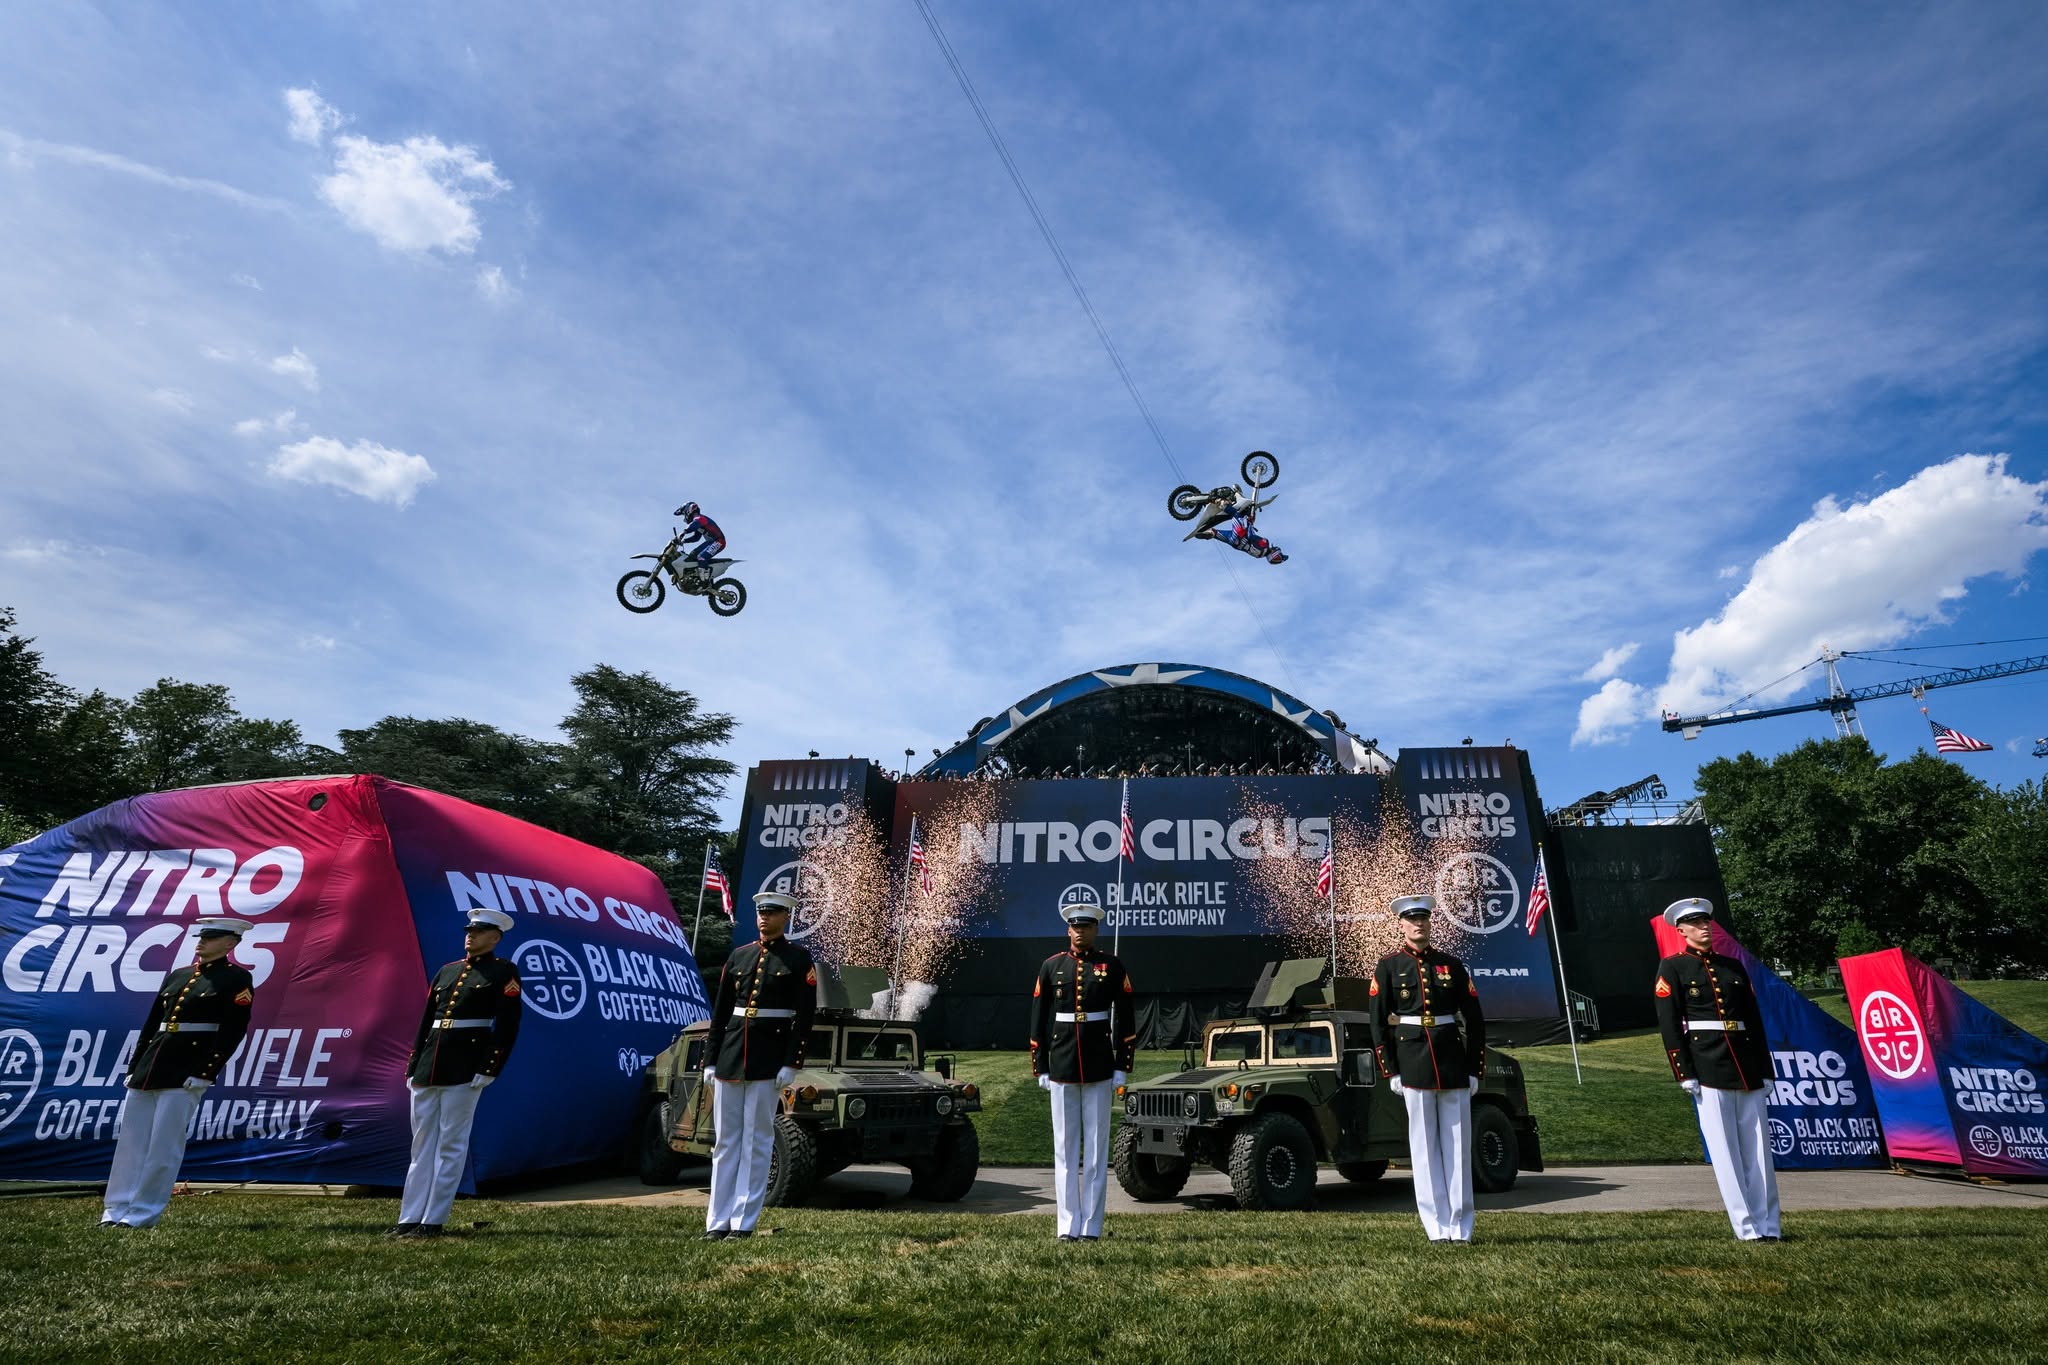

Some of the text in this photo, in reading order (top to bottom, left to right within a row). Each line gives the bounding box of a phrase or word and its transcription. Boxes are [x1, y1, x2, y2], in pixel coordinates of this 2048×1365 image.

[763, 803, 848, 826] NITRO
[1419, 792, 1510, 815] NITRO
[1421, 816, 1516, 837] CIRCUS
[959, 817, 1331, 864] NITRO CIRCUS
[34, 845, 305, 917] NITRO
[445, 871, 600, 922] NITRO
[1107, 881, 1227, 906] BLACK RIFLE
[1107, 909, 1226, 926] COFFEE COMPANY
[583, 943, 706, 1004] BLACK RIFLE
[1474, 968, 1529, 977] RAM
[598, 990, 661, 1023] COFFEE
[54, 1029, 140, 1087] BLA
[1948, 1066, 2037, 1092] NITRO
[1766, 1080, 1857, 1106] IRCUS
[1956, 1090, 2046, 1114] CIRCUS
[1794, 1118, 1847, 1138] BLACK
[2000, 1126, 2048, 1144] BLACK
[1800, 1140, 1881, 1156] COFFEE COMPA
[2008, 1146, 2046, 1160] COFFEE
